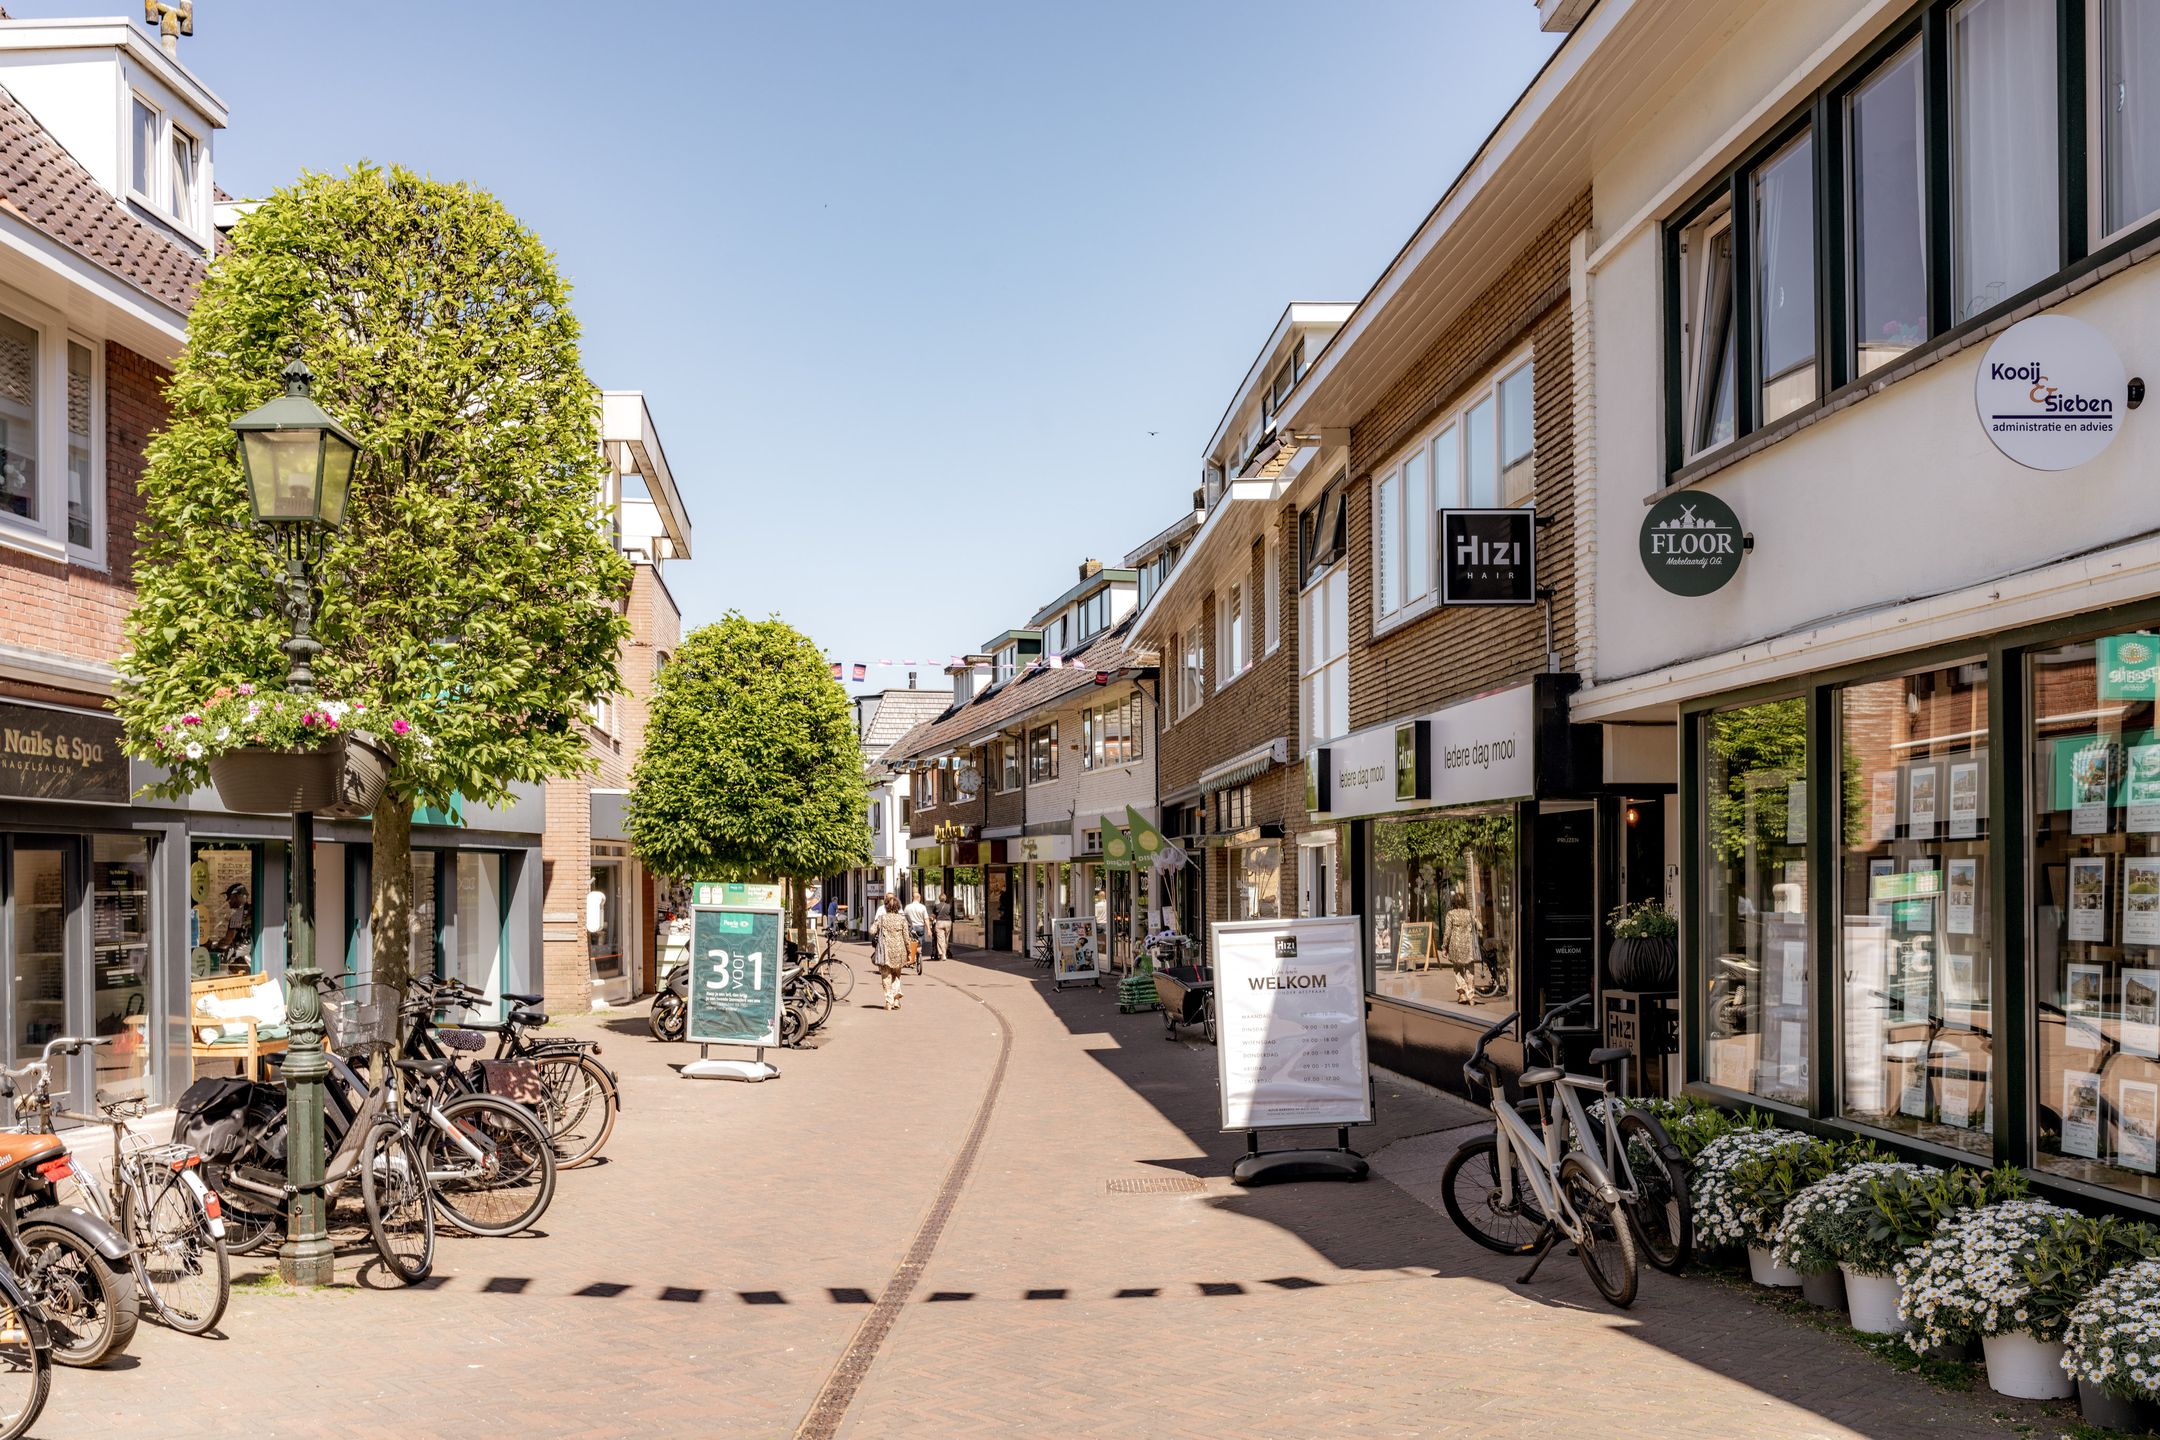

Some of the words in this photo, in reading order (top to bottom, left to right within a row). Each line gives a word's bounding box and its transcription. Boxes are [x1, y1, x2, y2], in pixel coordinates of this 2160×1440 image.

[1992, 362, 2041, 384] Kooij
[2044, 394, 2113, 412] Sieben
[1992, 422, 2062, 432] administratie
[2064, 424, 2077, 432] en
[2080, 422, 2113, 432] advies
[1457, 535, 1521, 565] HIZI
[1651, 533, 1734, 554] FLOOR
[1666, 557, 1708, 568] Makelaardij
[1709, 557, 1723, 565] O.G.
[1467, 571, 1515, 579] HAIR
[4, 728, 53, 757] Nails
[55, 734, 70, 760] &
[72, 736, 104, 768] Spa
[1398, 745, 1414, 770] HIZI
[1444, 744, 1470, 769] Iedere
[1472, 739, 1489, 770] dag
[1492, 732, 1516, 761] mooi
[2, 759, 72, 774] NAGELSALON
[1339, 769, 1356, 788] Iedere
[1358, 765, 1369, 789] dag
[1370, 760, 1385, 783] mooi
[1276, 940, 1295, 950] HIZI
[706, 949, 730, 990] 3
[732, 951, 745, 990] voor
[747, 952, 763, 991] 1
[1248, 974, 1327, 991] WELKOM
[1609, 1014, 1635, 1040] HIZI
